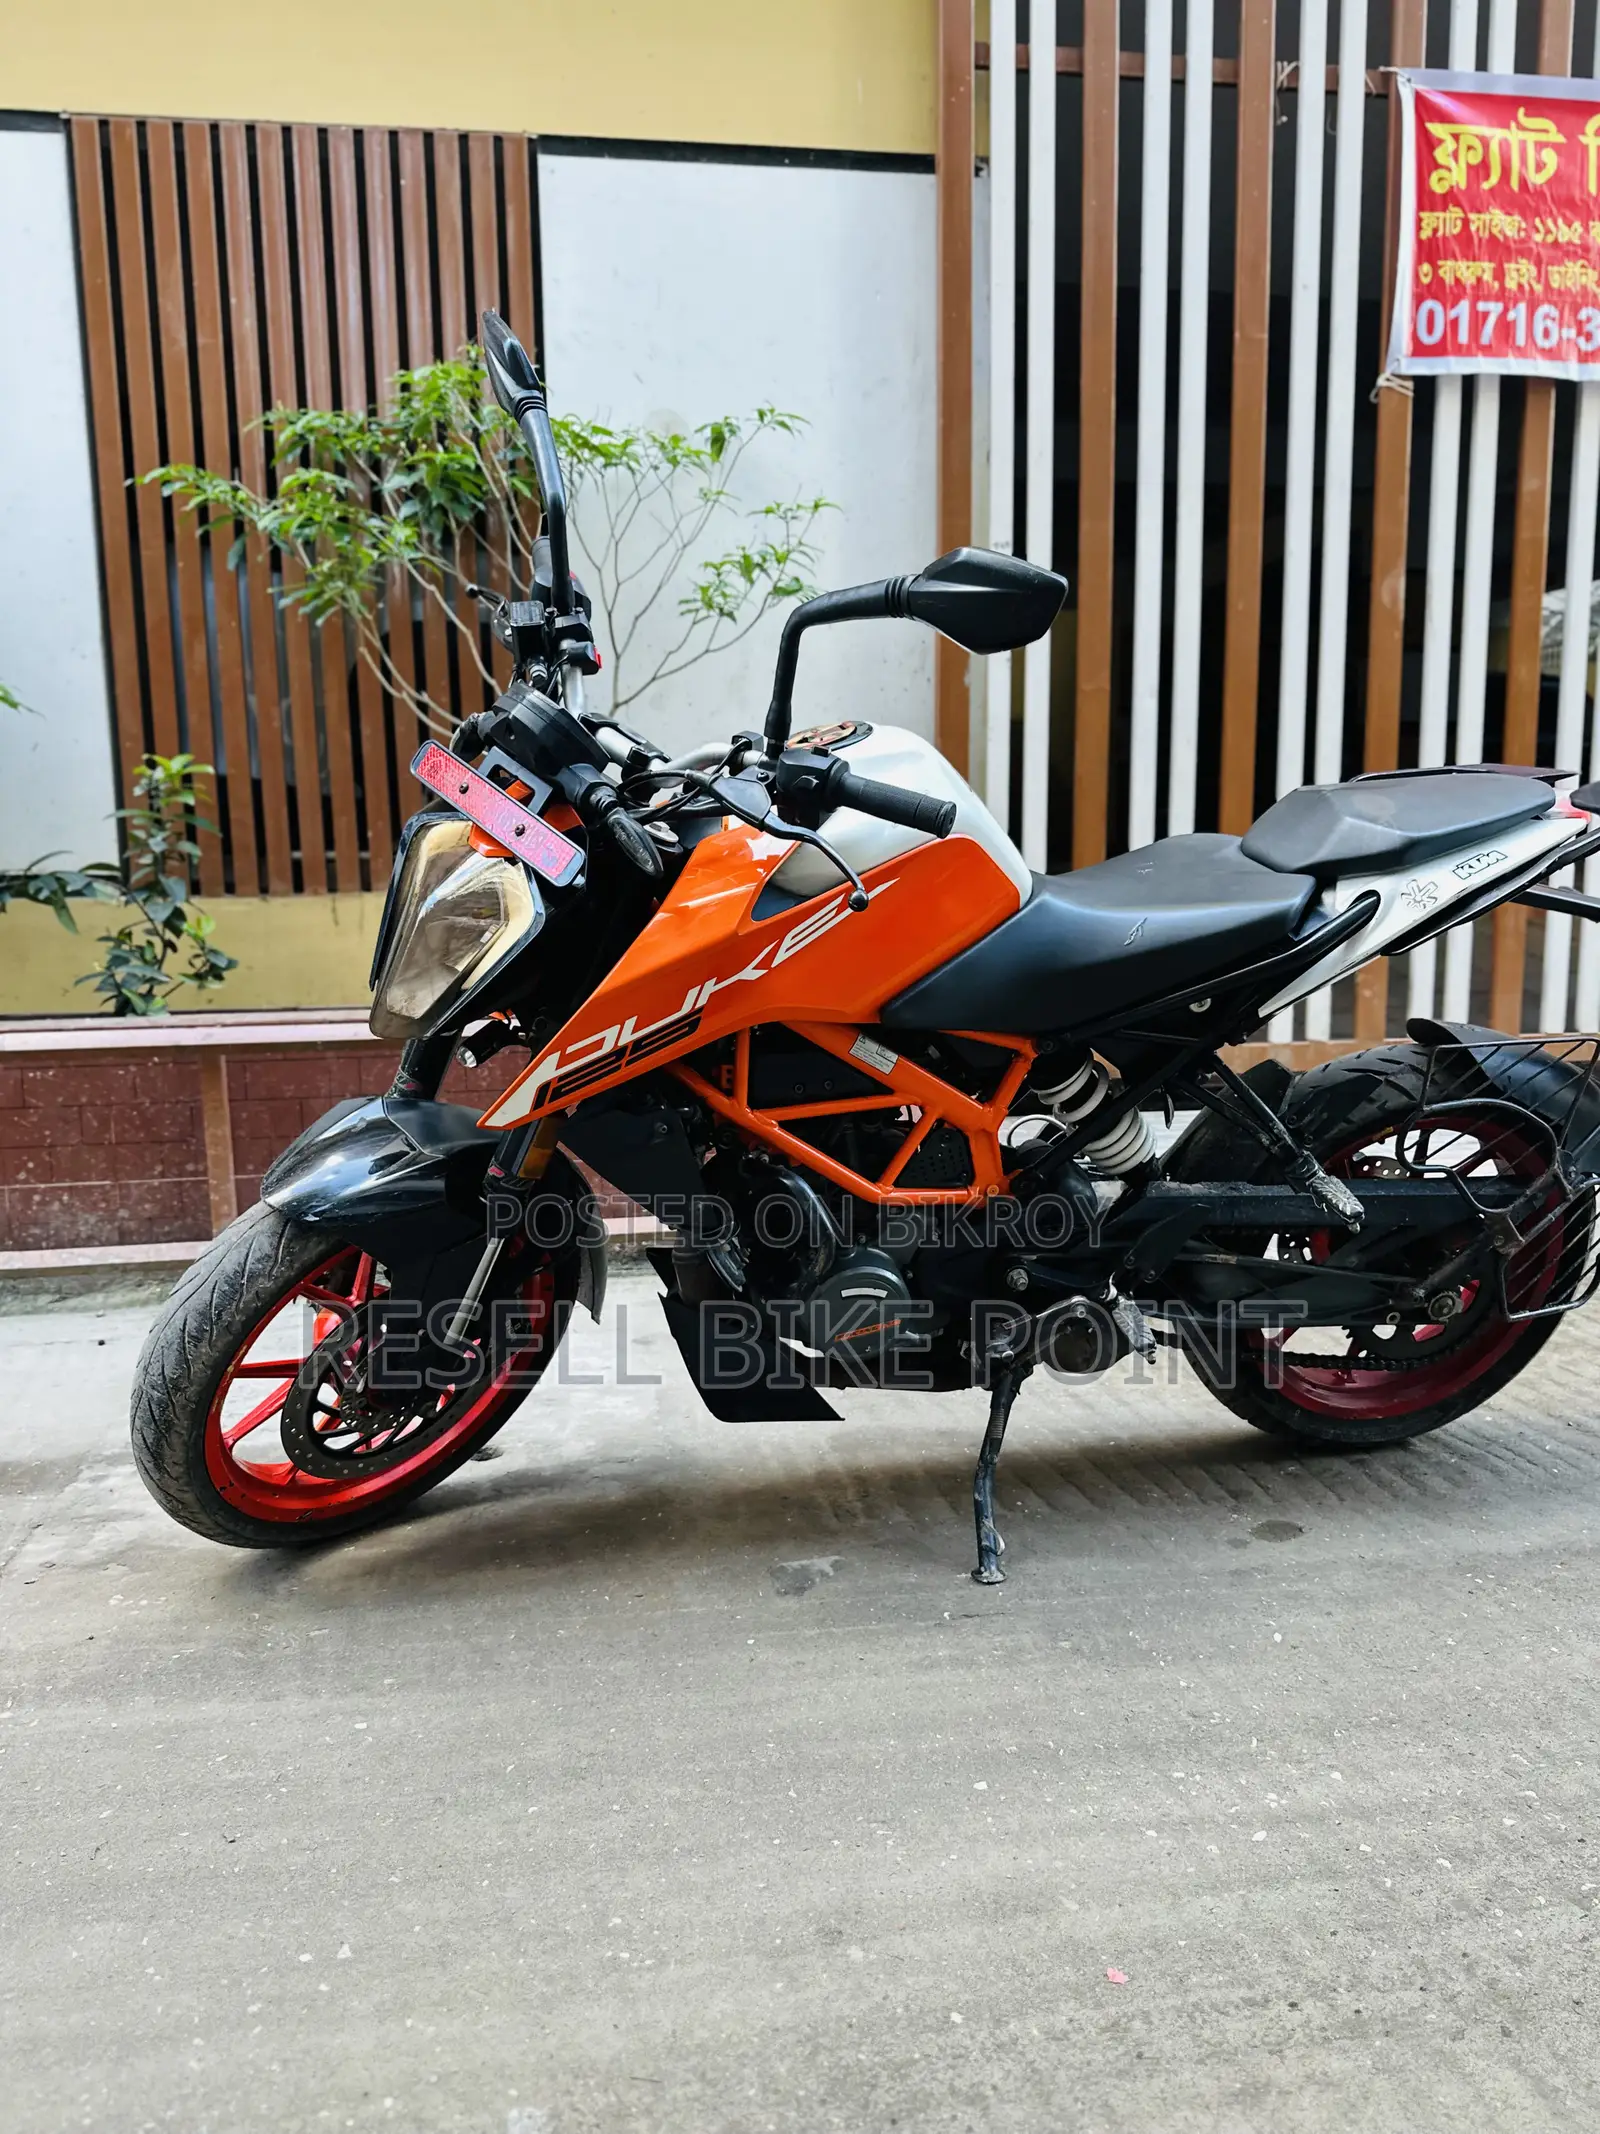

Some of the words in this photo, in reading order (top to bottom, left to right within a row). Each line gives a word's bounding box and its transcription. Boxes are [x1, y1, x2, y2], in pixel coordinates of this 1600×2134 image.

[1416, 299, 1600, 352] 01716-3
[1452, 850, 1508, 880] KTM
[545, 878, 899, 1080] DUKE
